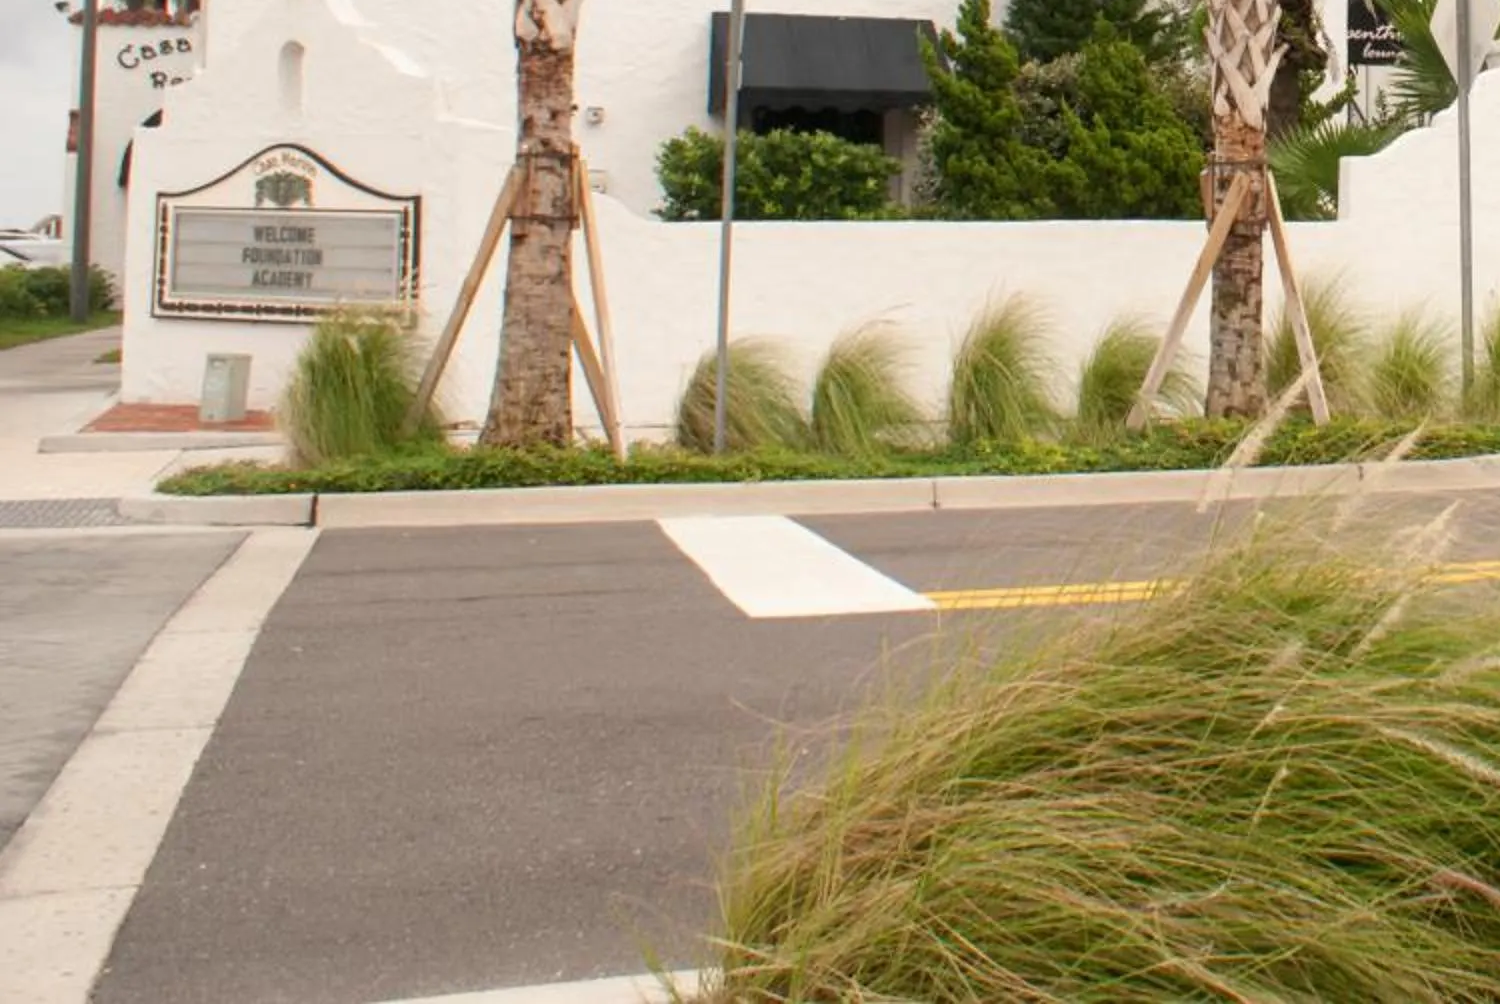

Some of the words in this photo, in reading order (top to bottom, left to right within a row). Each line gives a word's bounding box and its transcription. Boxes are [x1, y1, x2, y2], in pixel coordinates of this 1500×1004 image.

[116, 37, 193, 69] Casa
[253, 225, 315, 244] WELCOME
[242, 246, 323, 267] FOUNDATION
[251, 269, 314, 288] ACADEMY
